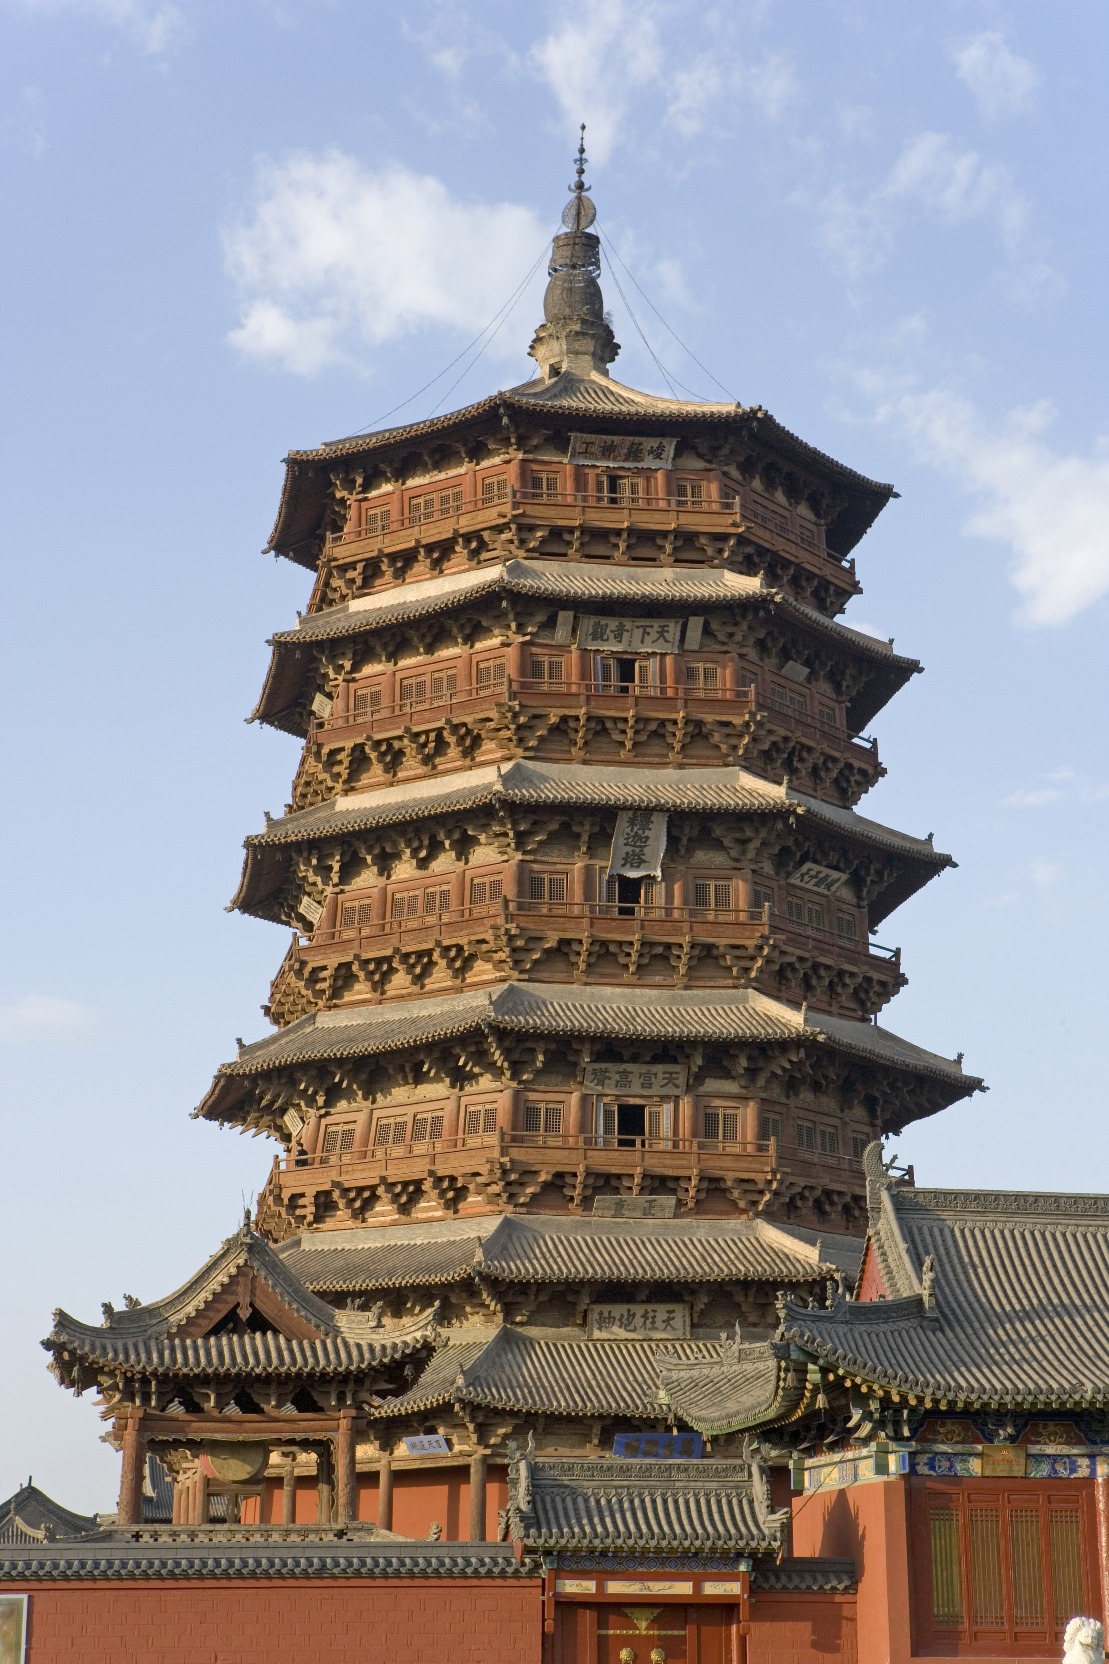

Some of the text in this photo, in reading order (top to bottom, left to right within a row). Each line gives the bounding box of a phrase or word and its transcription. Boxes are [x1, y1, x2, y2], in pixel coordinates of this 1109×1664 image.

[589, 620, 673, 644] 天下奇觀
[621, 811, 654, 868] 釋迦塔
[611, 1199, 657, 1216] 正直
[595, 1308, 680, 1332] 天柱地軸
